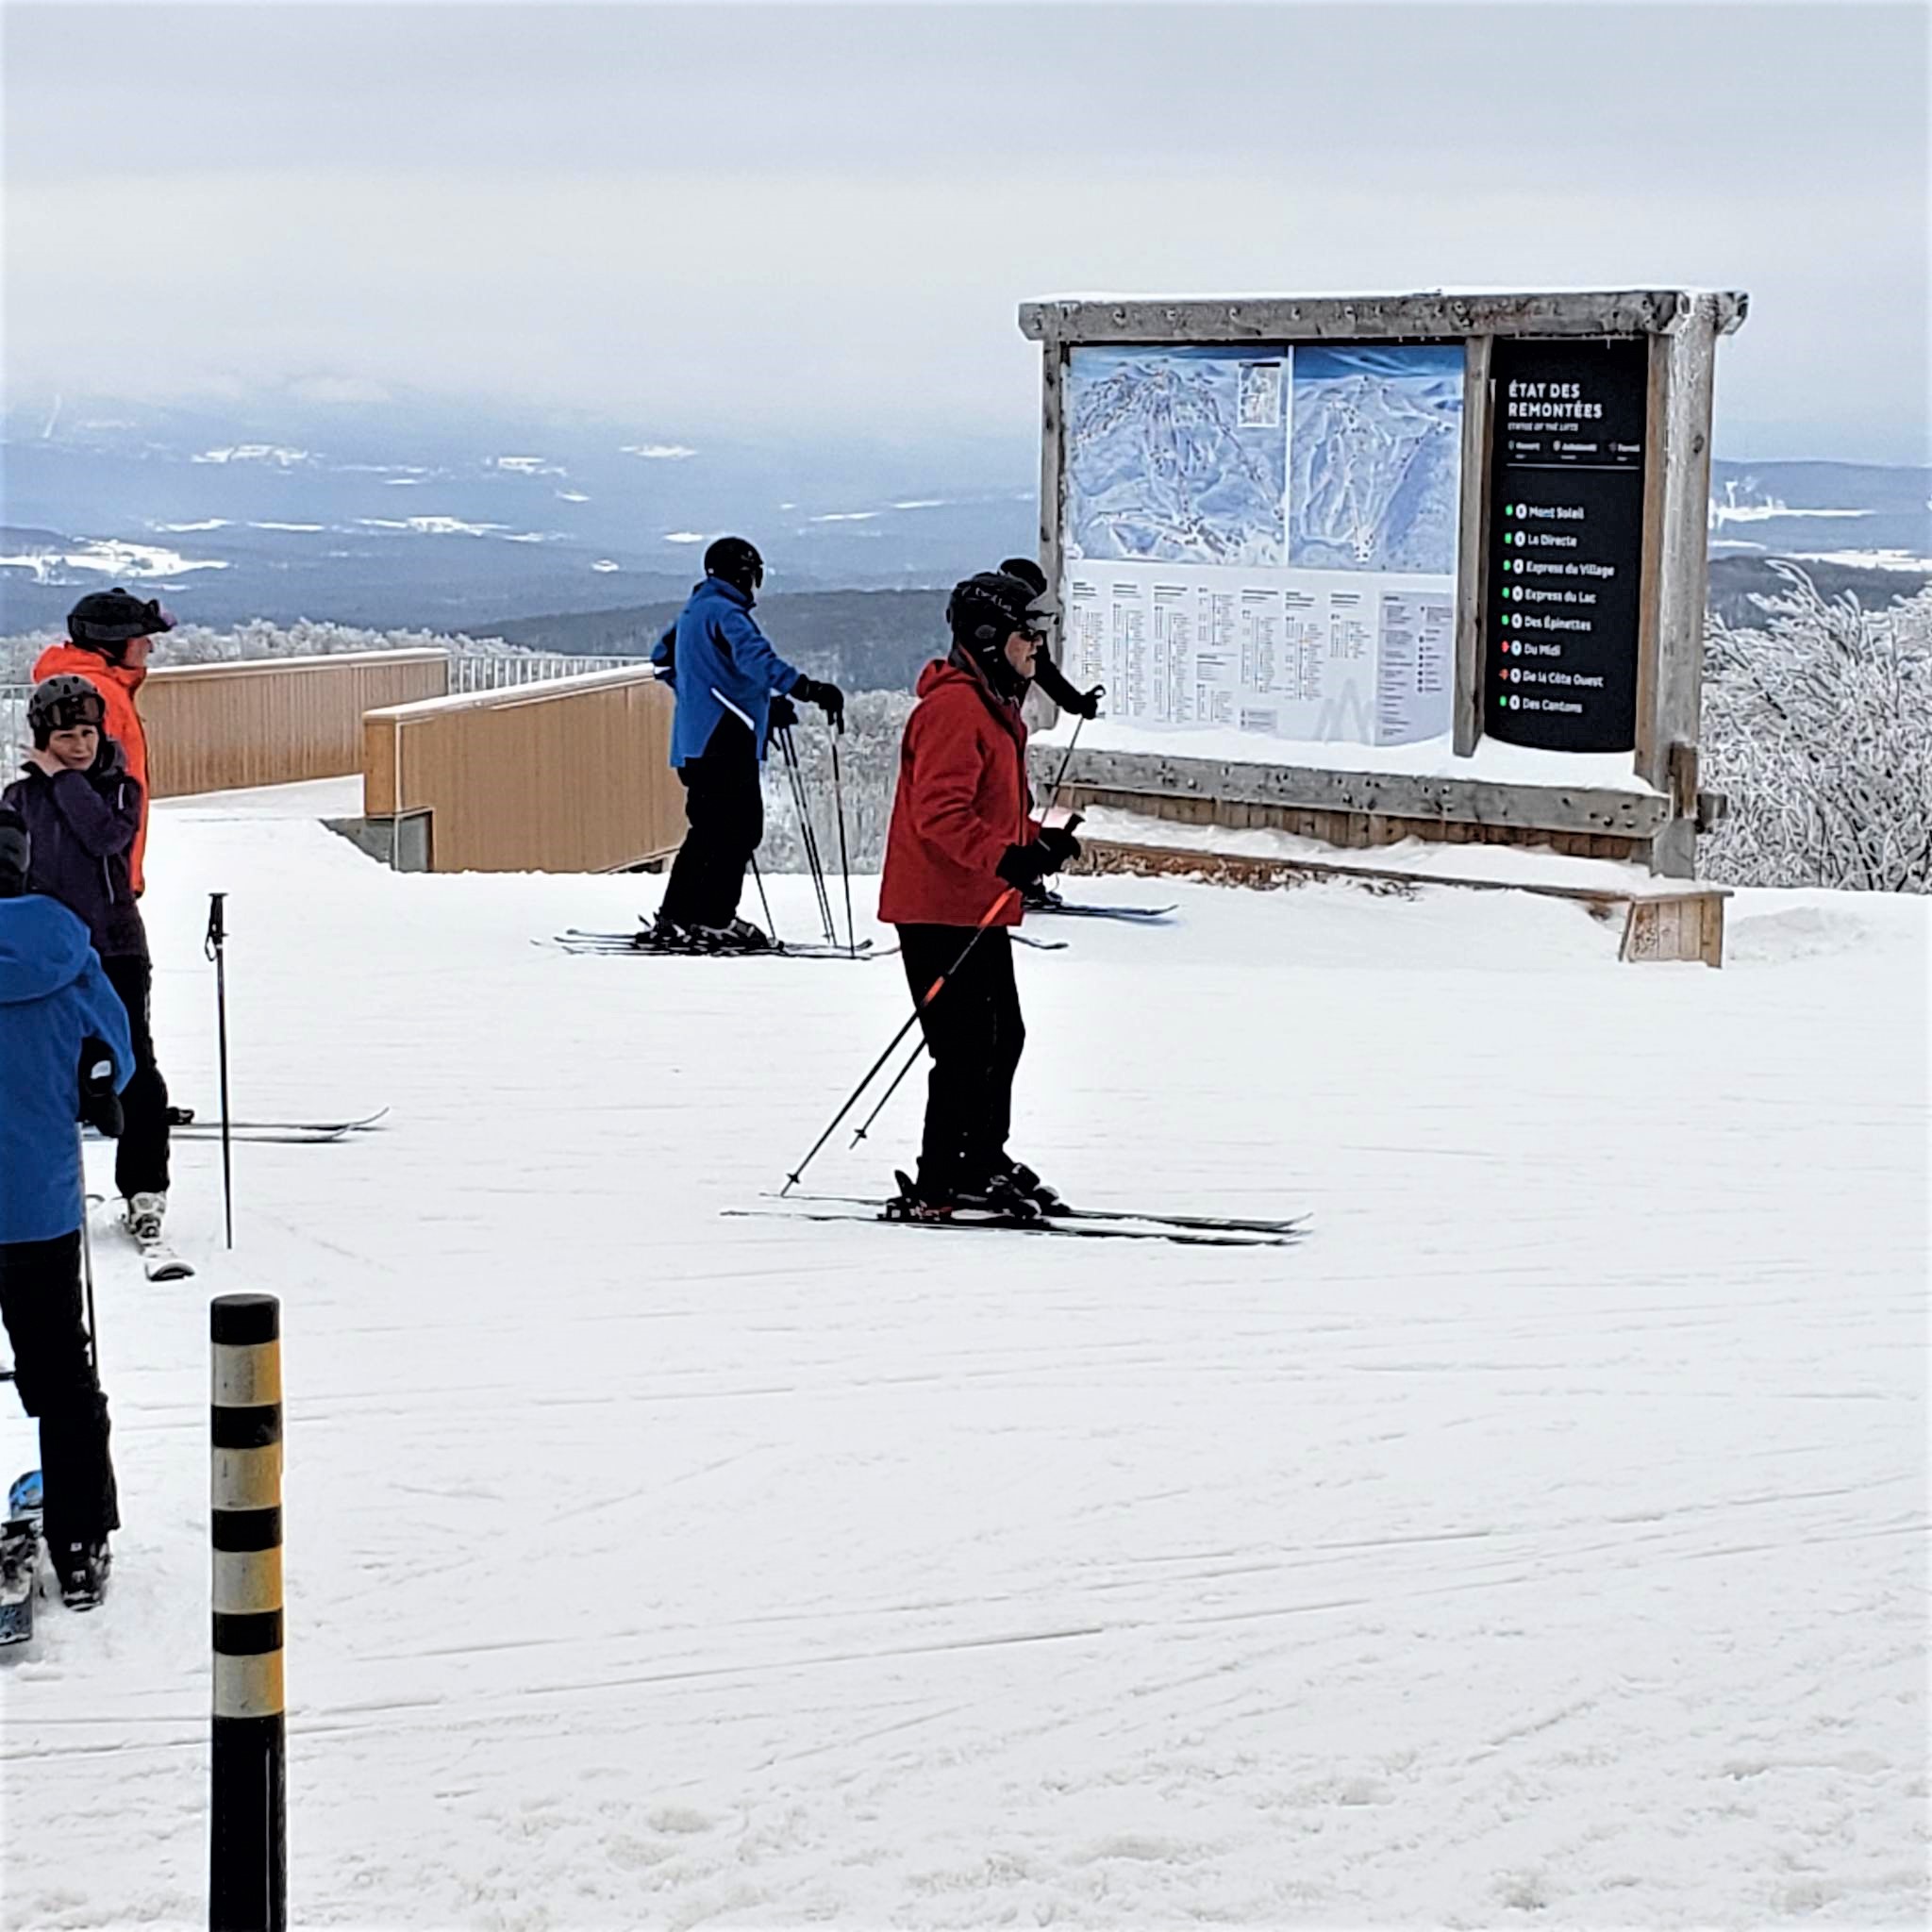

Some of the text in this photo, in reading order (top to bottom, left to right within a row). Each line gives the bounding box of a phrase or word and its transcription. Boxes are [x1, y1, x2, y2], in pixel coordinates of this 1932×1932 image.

[1508, 379, 1580, 398] ÉTAT DES
[1508, 400, 1603, 418] REMONTÉES
[1527, 534, 1539, 545] La
[1565, 563, 1578, 575] du
[1579, 563, 1615, 579] Village
[1564, 591, 1576, 603] du
[1578, 591, 1596, 604] Lac
[1524, 615, 1542, 627] Des
[1524, 643, 1538, 656] Du
